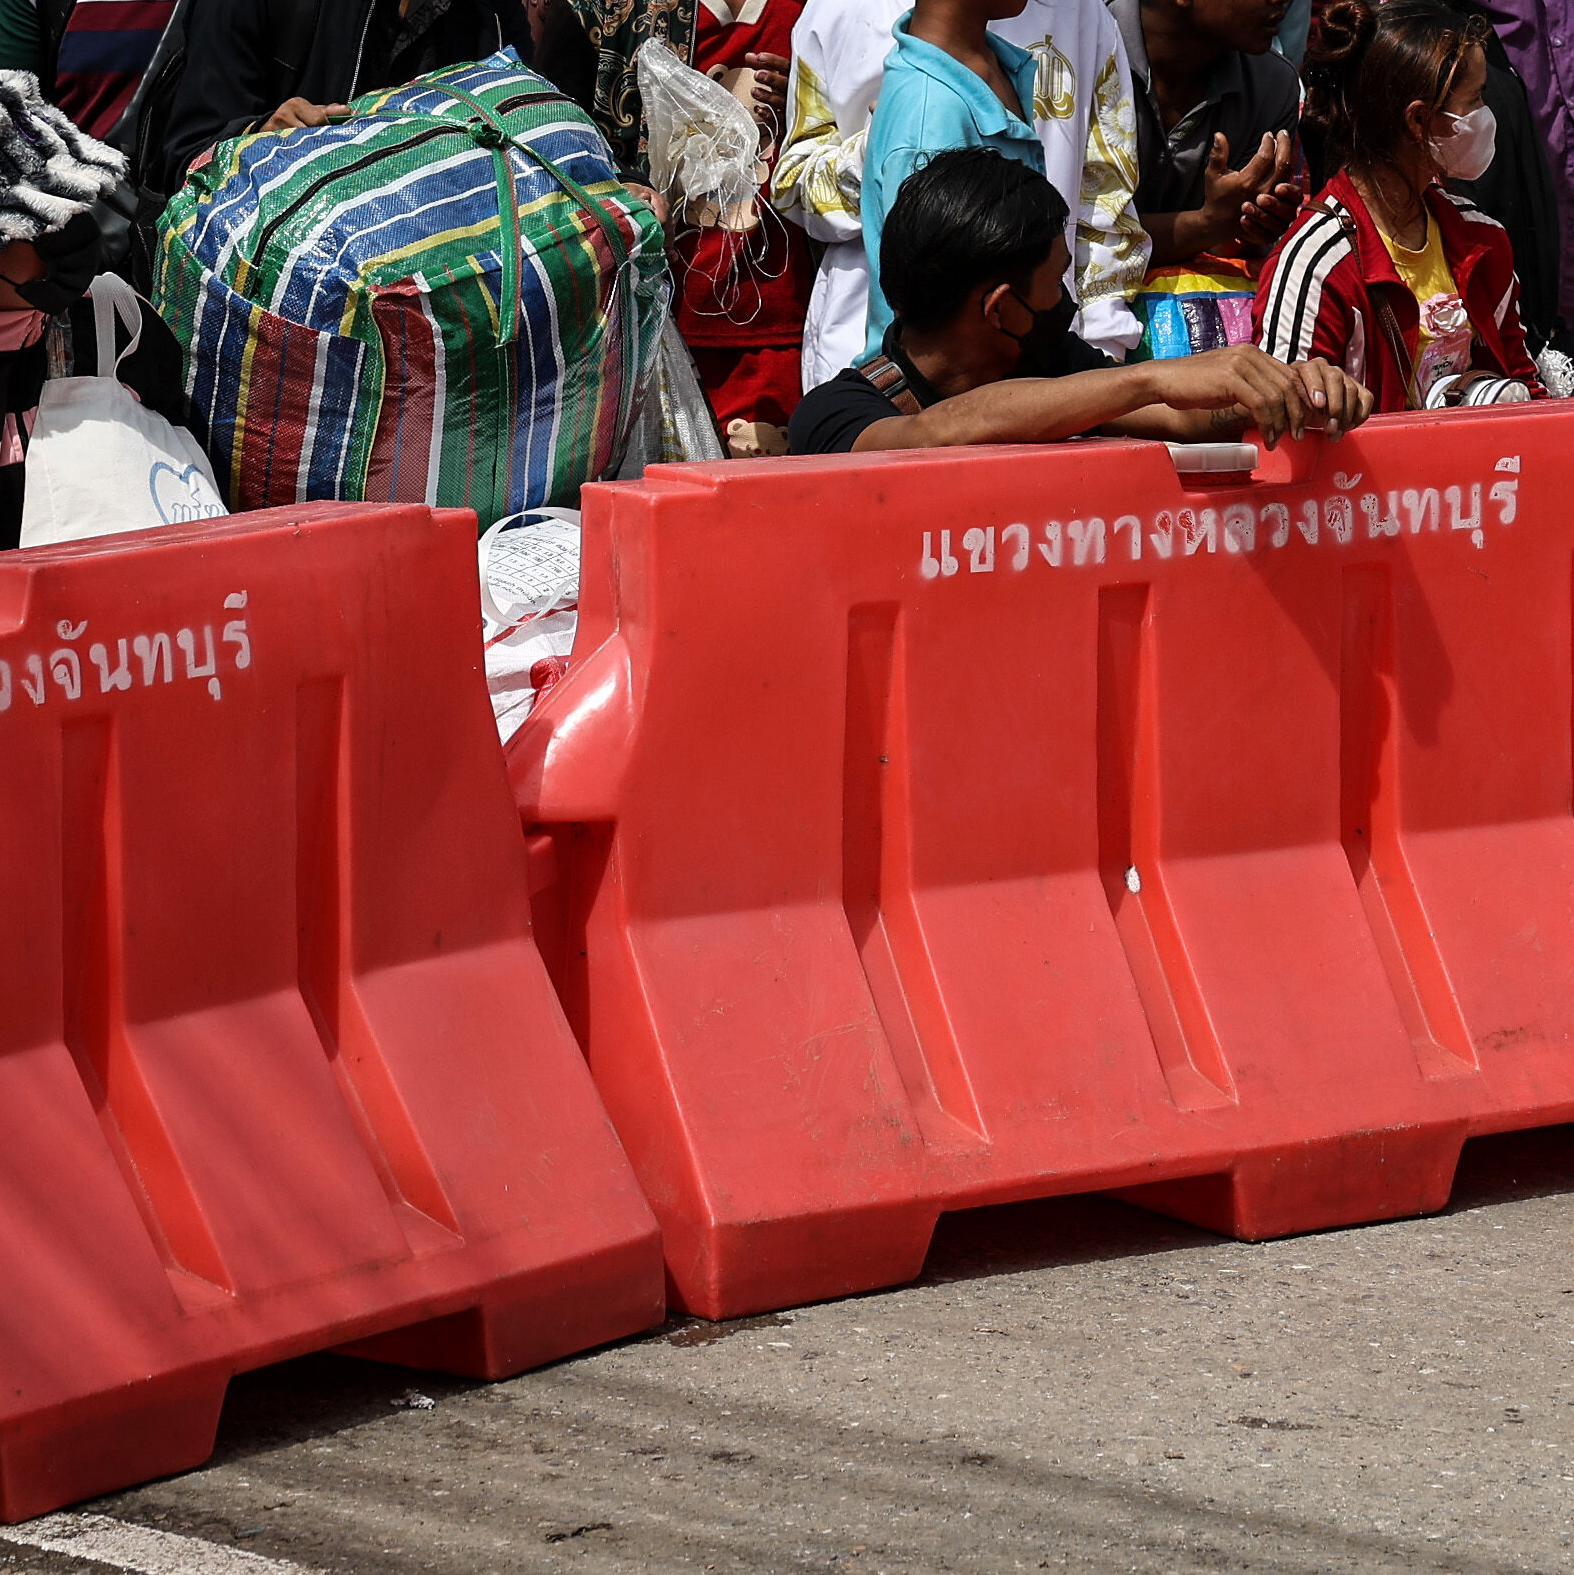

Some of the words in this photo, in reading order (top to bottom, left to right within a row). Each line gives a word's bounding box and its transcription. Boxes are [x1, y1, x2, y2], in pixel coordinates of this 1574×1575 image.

[918, 454, 1523, 581] แขวงทางหลวงจันทบุรี
